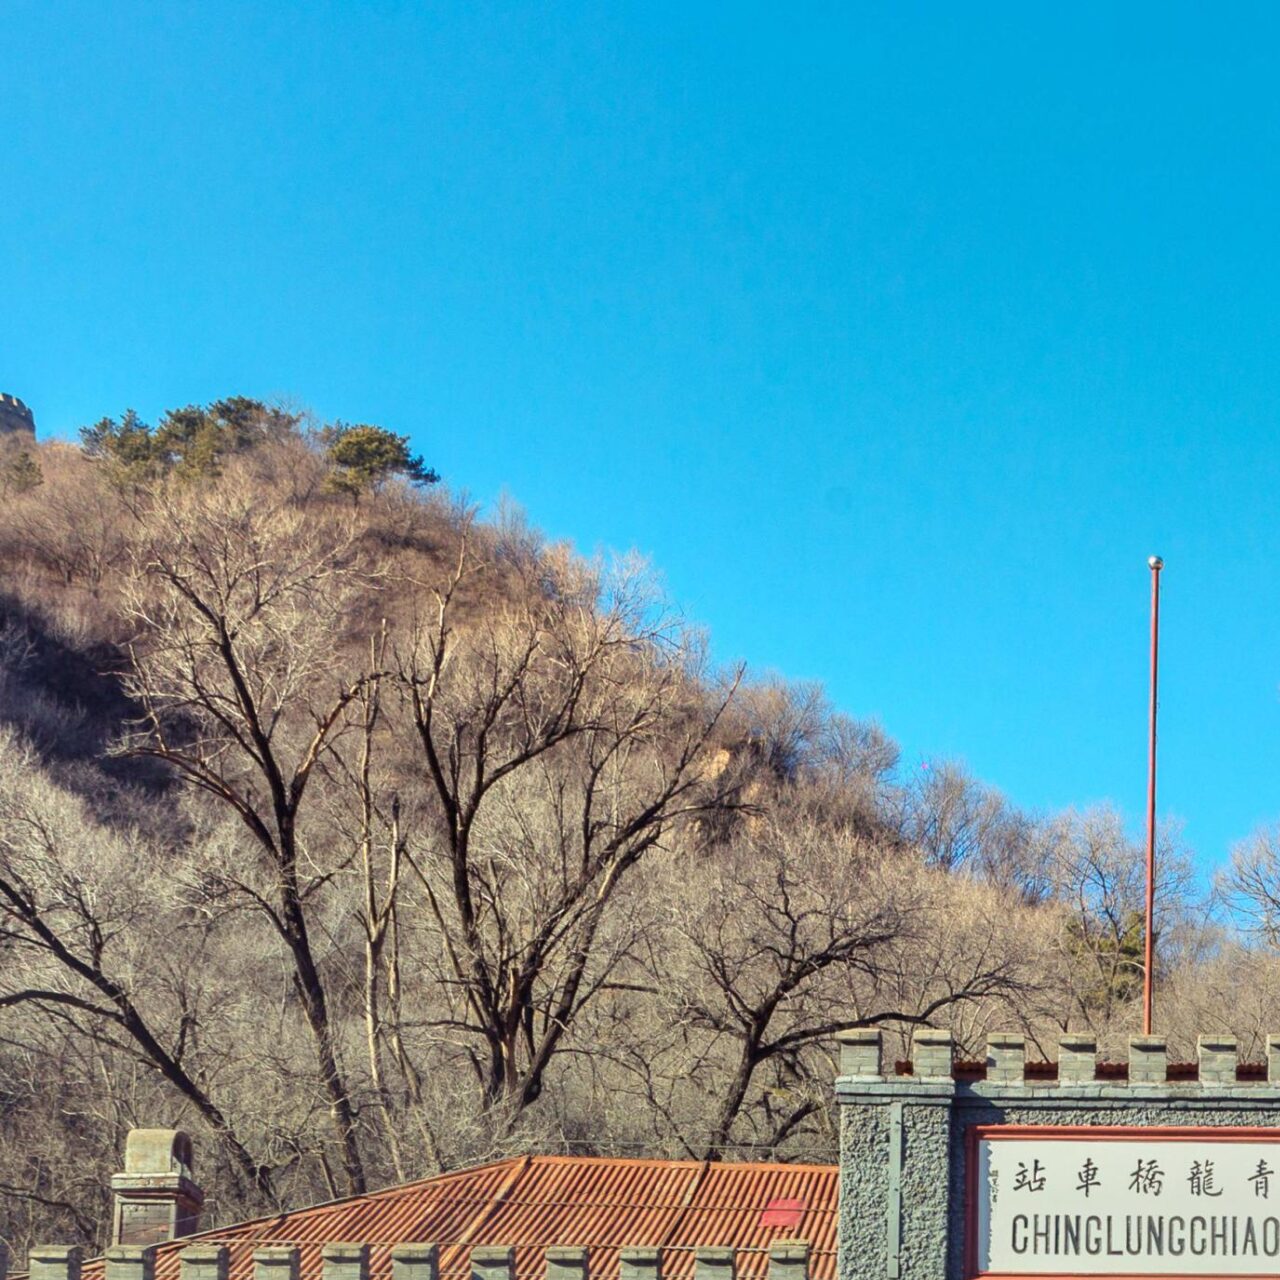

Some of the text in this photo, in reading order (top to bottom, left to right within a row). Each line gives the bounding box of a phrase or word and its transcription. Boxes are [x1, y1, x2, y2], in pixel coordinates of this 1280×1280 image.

[1013, 1158, 1275, 1199] 青龍橋車站
[1011, 1213, 1280, 1257] CHINGLUNGCHIAO
